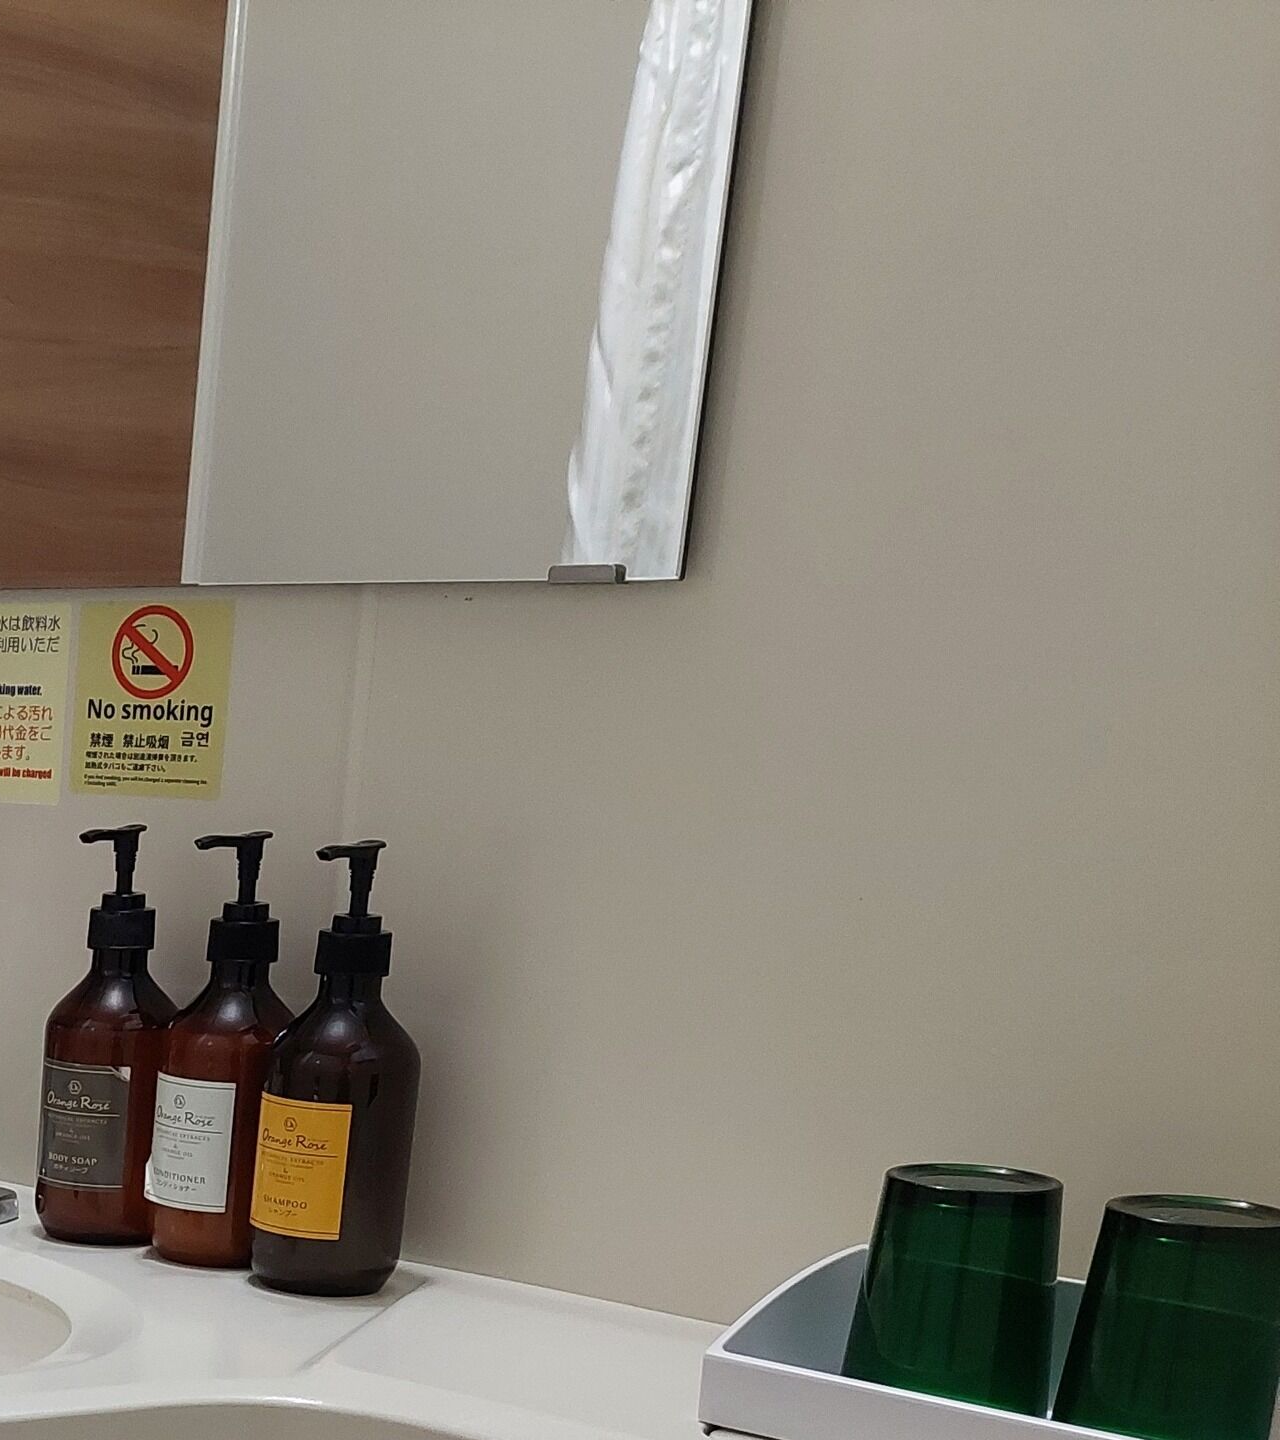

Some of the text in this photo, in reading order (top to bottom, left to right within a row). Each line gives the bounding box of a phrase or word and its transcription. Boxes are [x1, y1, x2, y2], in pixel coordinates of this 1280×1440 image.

[17, 685, 42, 696] water.
[88, 699, 213, 727] No smoking
[90, 732, 114, 748] 禁煙
[181, 731, 210, 748] 금연
[12, 767, 20, 777] be
[22, 768, 52, 779] charged
[47, 1091, 110, 1111] Orange Rose
[157, 1105, 214, 1127] Orange Rose
[262, 1128, 327, 1150] Orange Rose
[48, 1152, 97, 1166] BODY SOAP
[153, 1167, 206, 1184] CONDITIONER
[263, 1194, 308, 1209] SHAMPOO
